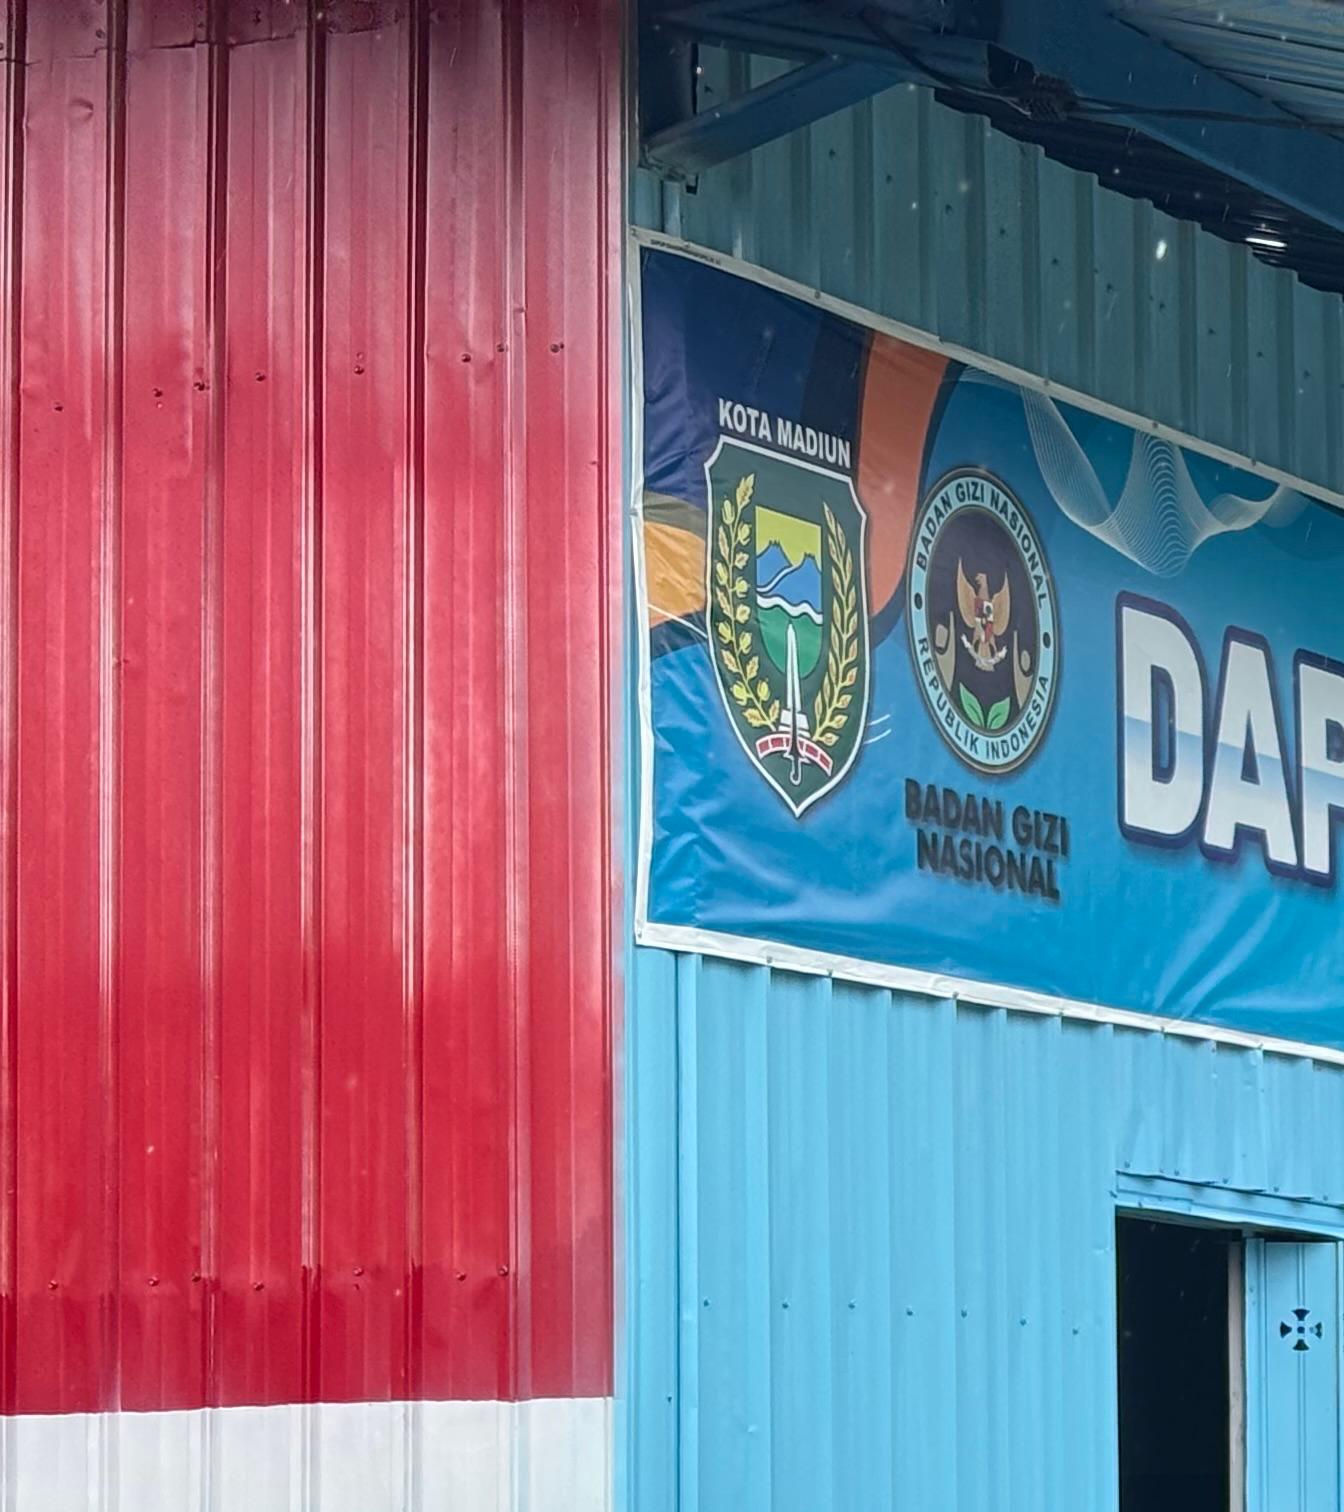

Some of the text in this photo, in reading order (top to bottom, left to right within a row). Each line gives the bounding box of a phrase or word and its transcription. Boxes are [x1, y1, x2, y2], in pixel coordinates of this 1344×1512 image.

[718, 397, 851, 469] KOTA MADIUN
[914, 480, 1049, 610] BADAN GIZI NASIONAL
[918, 636, 1050, 761] REPUBLIK INDONESIA
[905, 777, 1071, 857] BADAN GIZI
[917, 828, 1060, 901] NASIONAL
